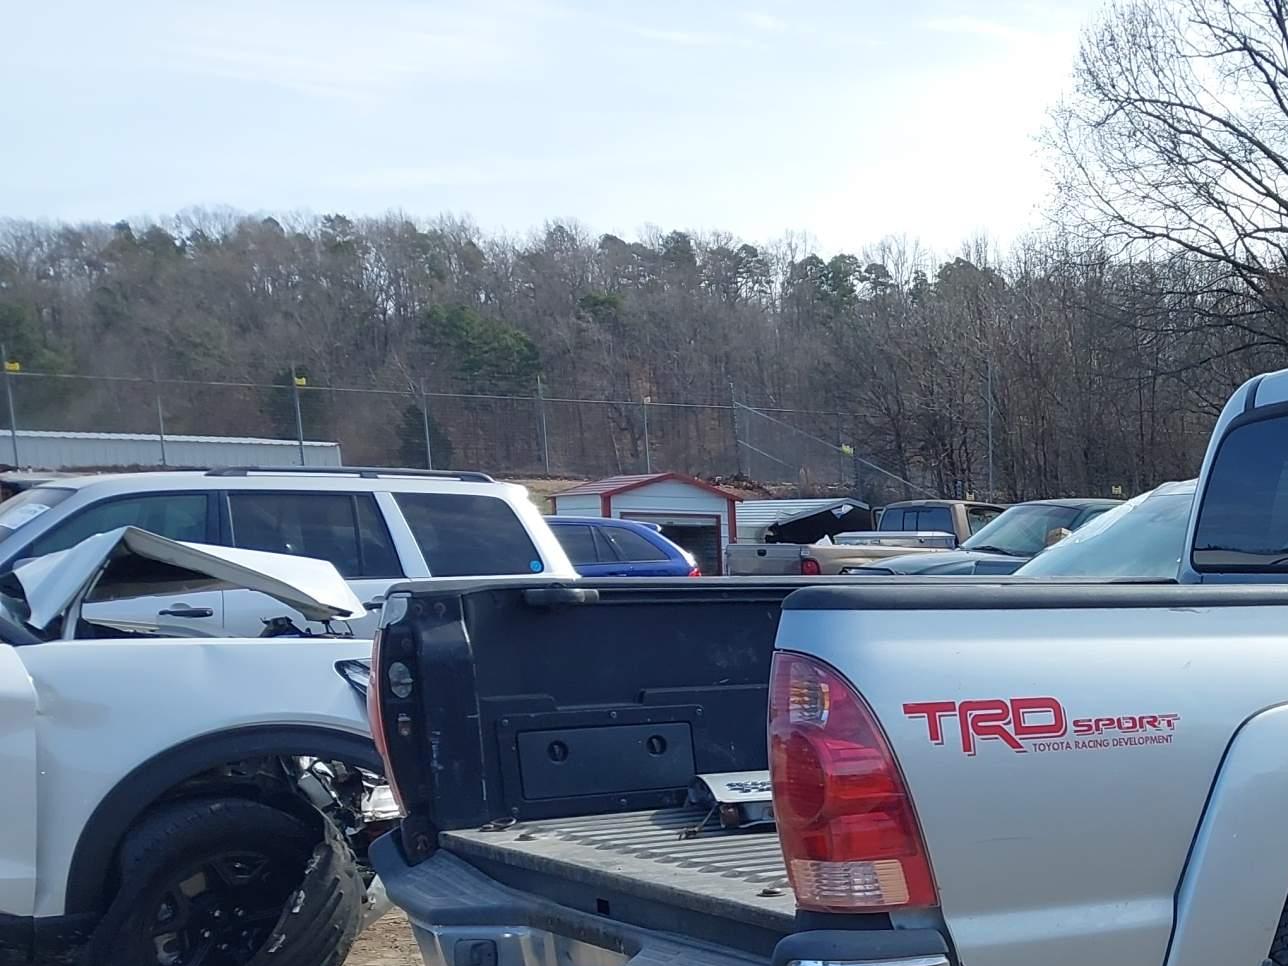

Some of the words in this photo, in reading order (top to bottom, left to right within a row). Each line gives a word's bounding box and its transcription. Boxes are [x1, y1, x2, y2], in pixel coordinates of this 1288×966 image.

[902, 696, 1068, 756] TRD
[1072, 713, 1181, 736] SPORT
[1032, 741, 1072, 753] TOYOTA
[1074, 737, 1110, 750] RACING
[1112, 734, 1174, 748] DEVELOPMENT
